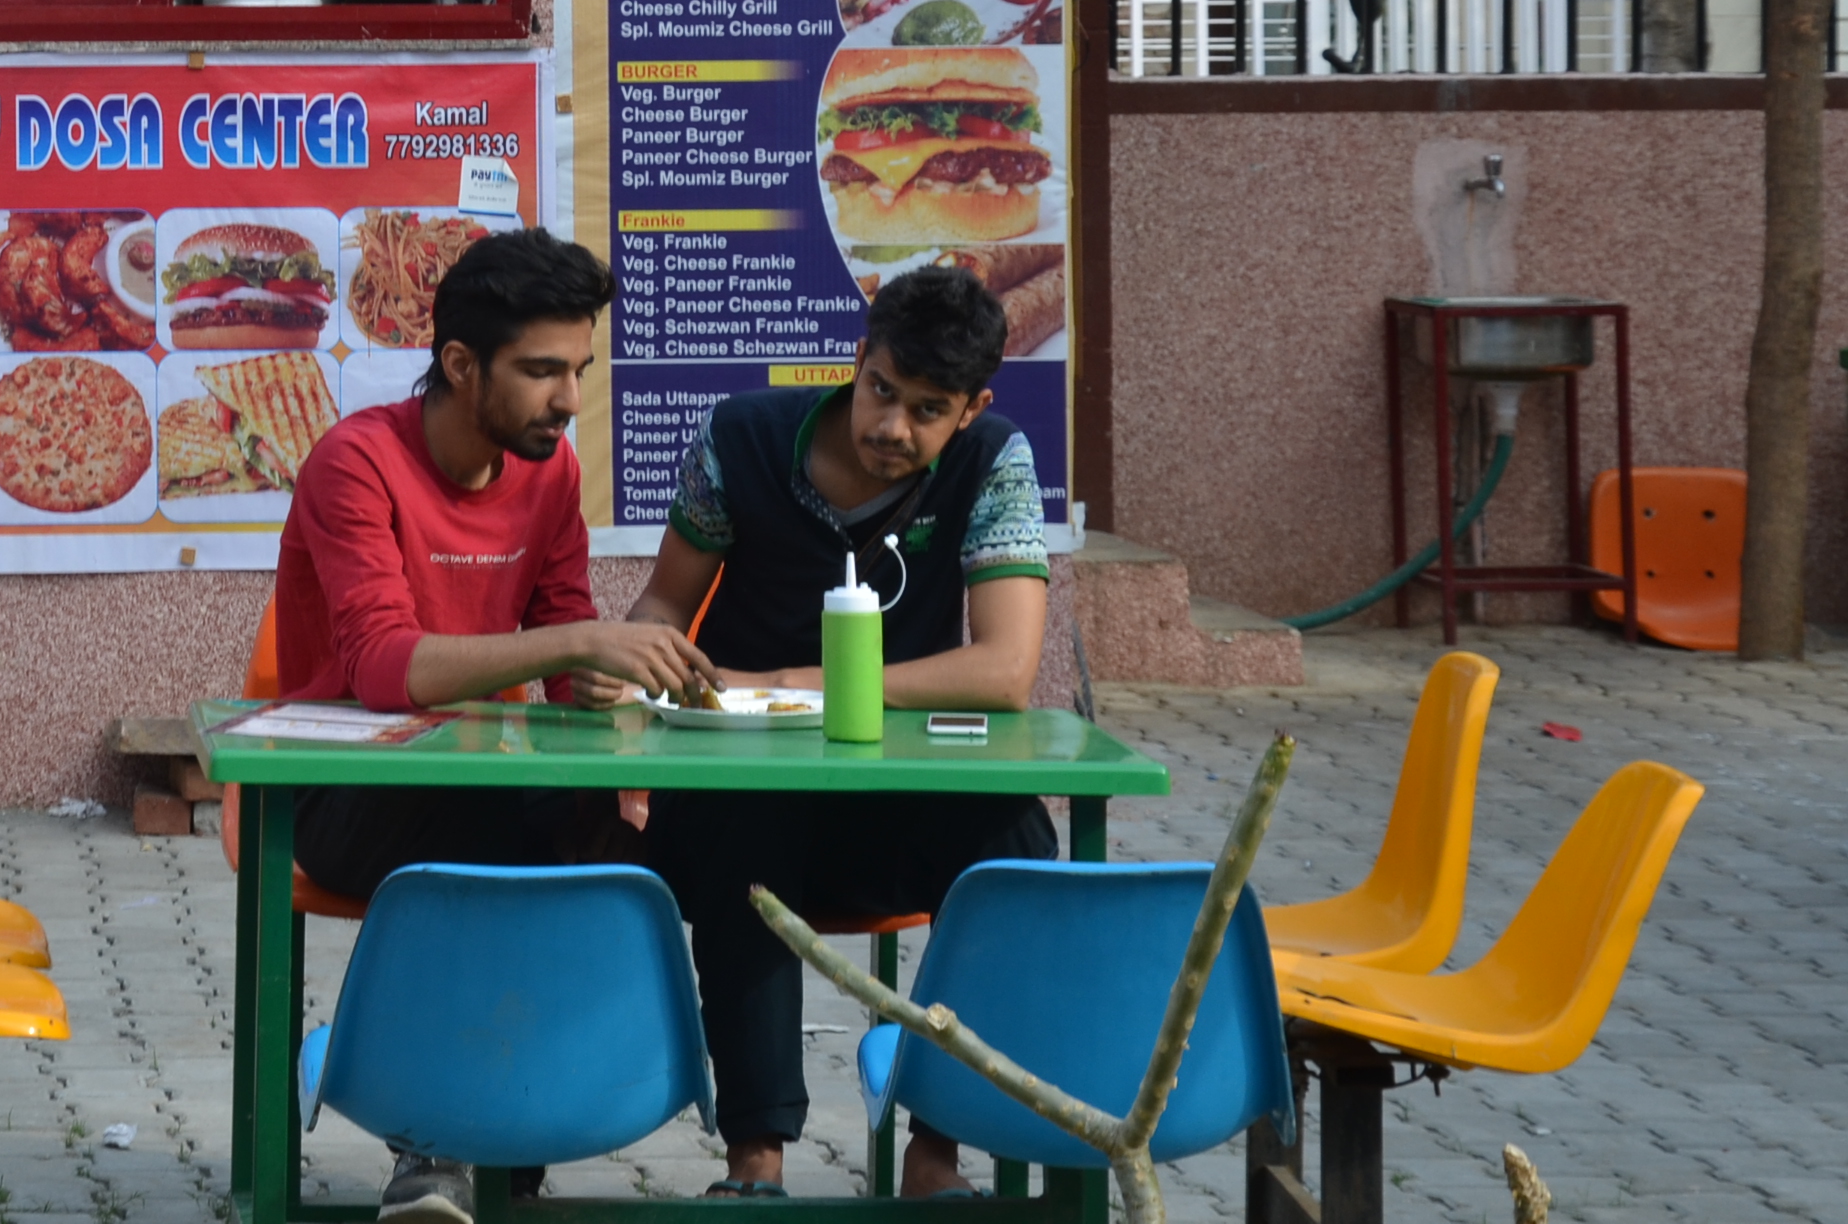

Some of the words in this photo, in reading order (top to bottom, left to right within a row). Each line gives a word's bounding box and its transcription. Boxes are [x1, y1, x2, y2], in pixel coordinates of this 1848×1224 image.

[620, 0, 684, 16] Cheese
[688, 0, 737, 18] Chilly
[741, 0, 777, 14] Grill
[622, 64, 698, 79] BURGER
[620, 85, 658, 104] Veg.
[663, 85, 722, 103] Burger
[414, 101, 488, 126] Kamal
[15, 92, 164, 171] DOSA
[178, 91, 369, 169] CENTER
[384, 133, 520, 160] 7792981336
[622, 149, 682, 164] Paneer
[685, 148, 749, 164] Cheese
[754, 148, 813, 166] Burger
[622, 213, 686, 228] Frankie
[622, 234, 659, 253] Veg.
[664, 234, 727, 249] Frankie
[622, 276, 659, 295] Veg.
[664, 276, 724, 291] Paneer
[728, 275, 792, 291] Frankie
[622, 390, 661, 407] Sada
[622, 409, 681, 426] Cheese
[623, 428, 678, 444] Paneer
[623, 447, 678, 463] Paneer
[623, 467, 671, 482] Onion
